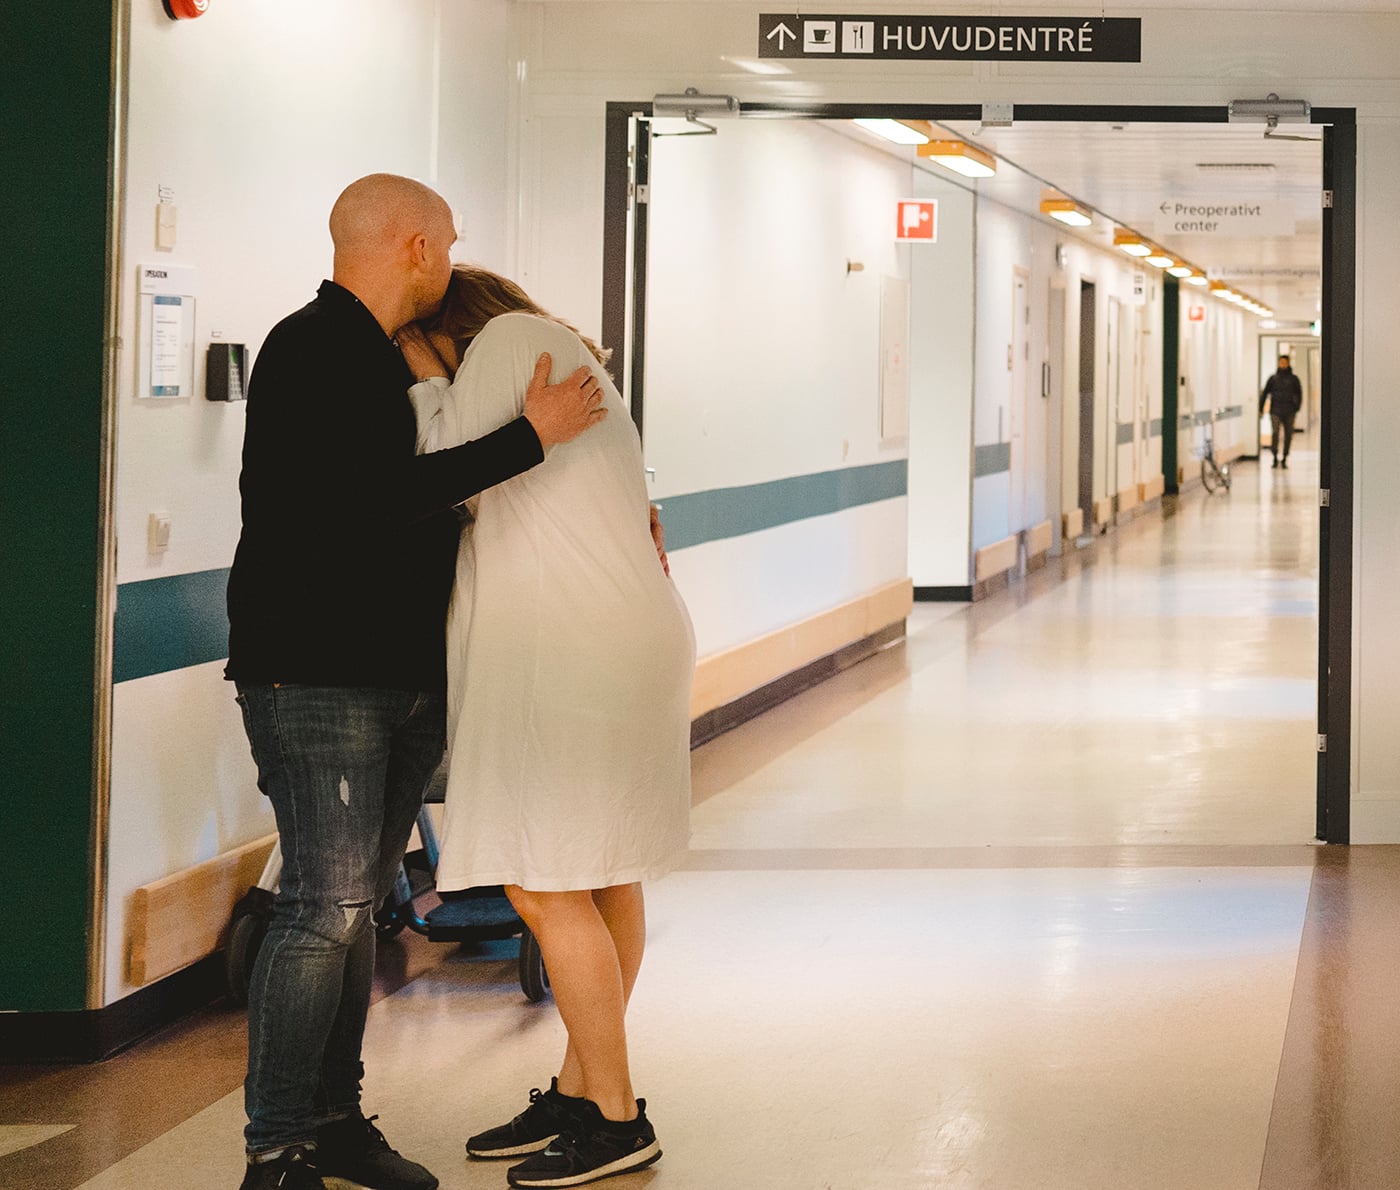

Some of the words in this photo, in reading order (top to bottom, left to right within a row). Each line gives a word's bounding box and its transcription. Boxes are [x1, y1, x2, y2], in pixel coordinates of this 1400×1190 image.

[883, 22, 1093, 51] HUVUDENTRÉ
[1175, 203, 1261, 218] Preoperativt
[1174, 221, 1219, 232] center
